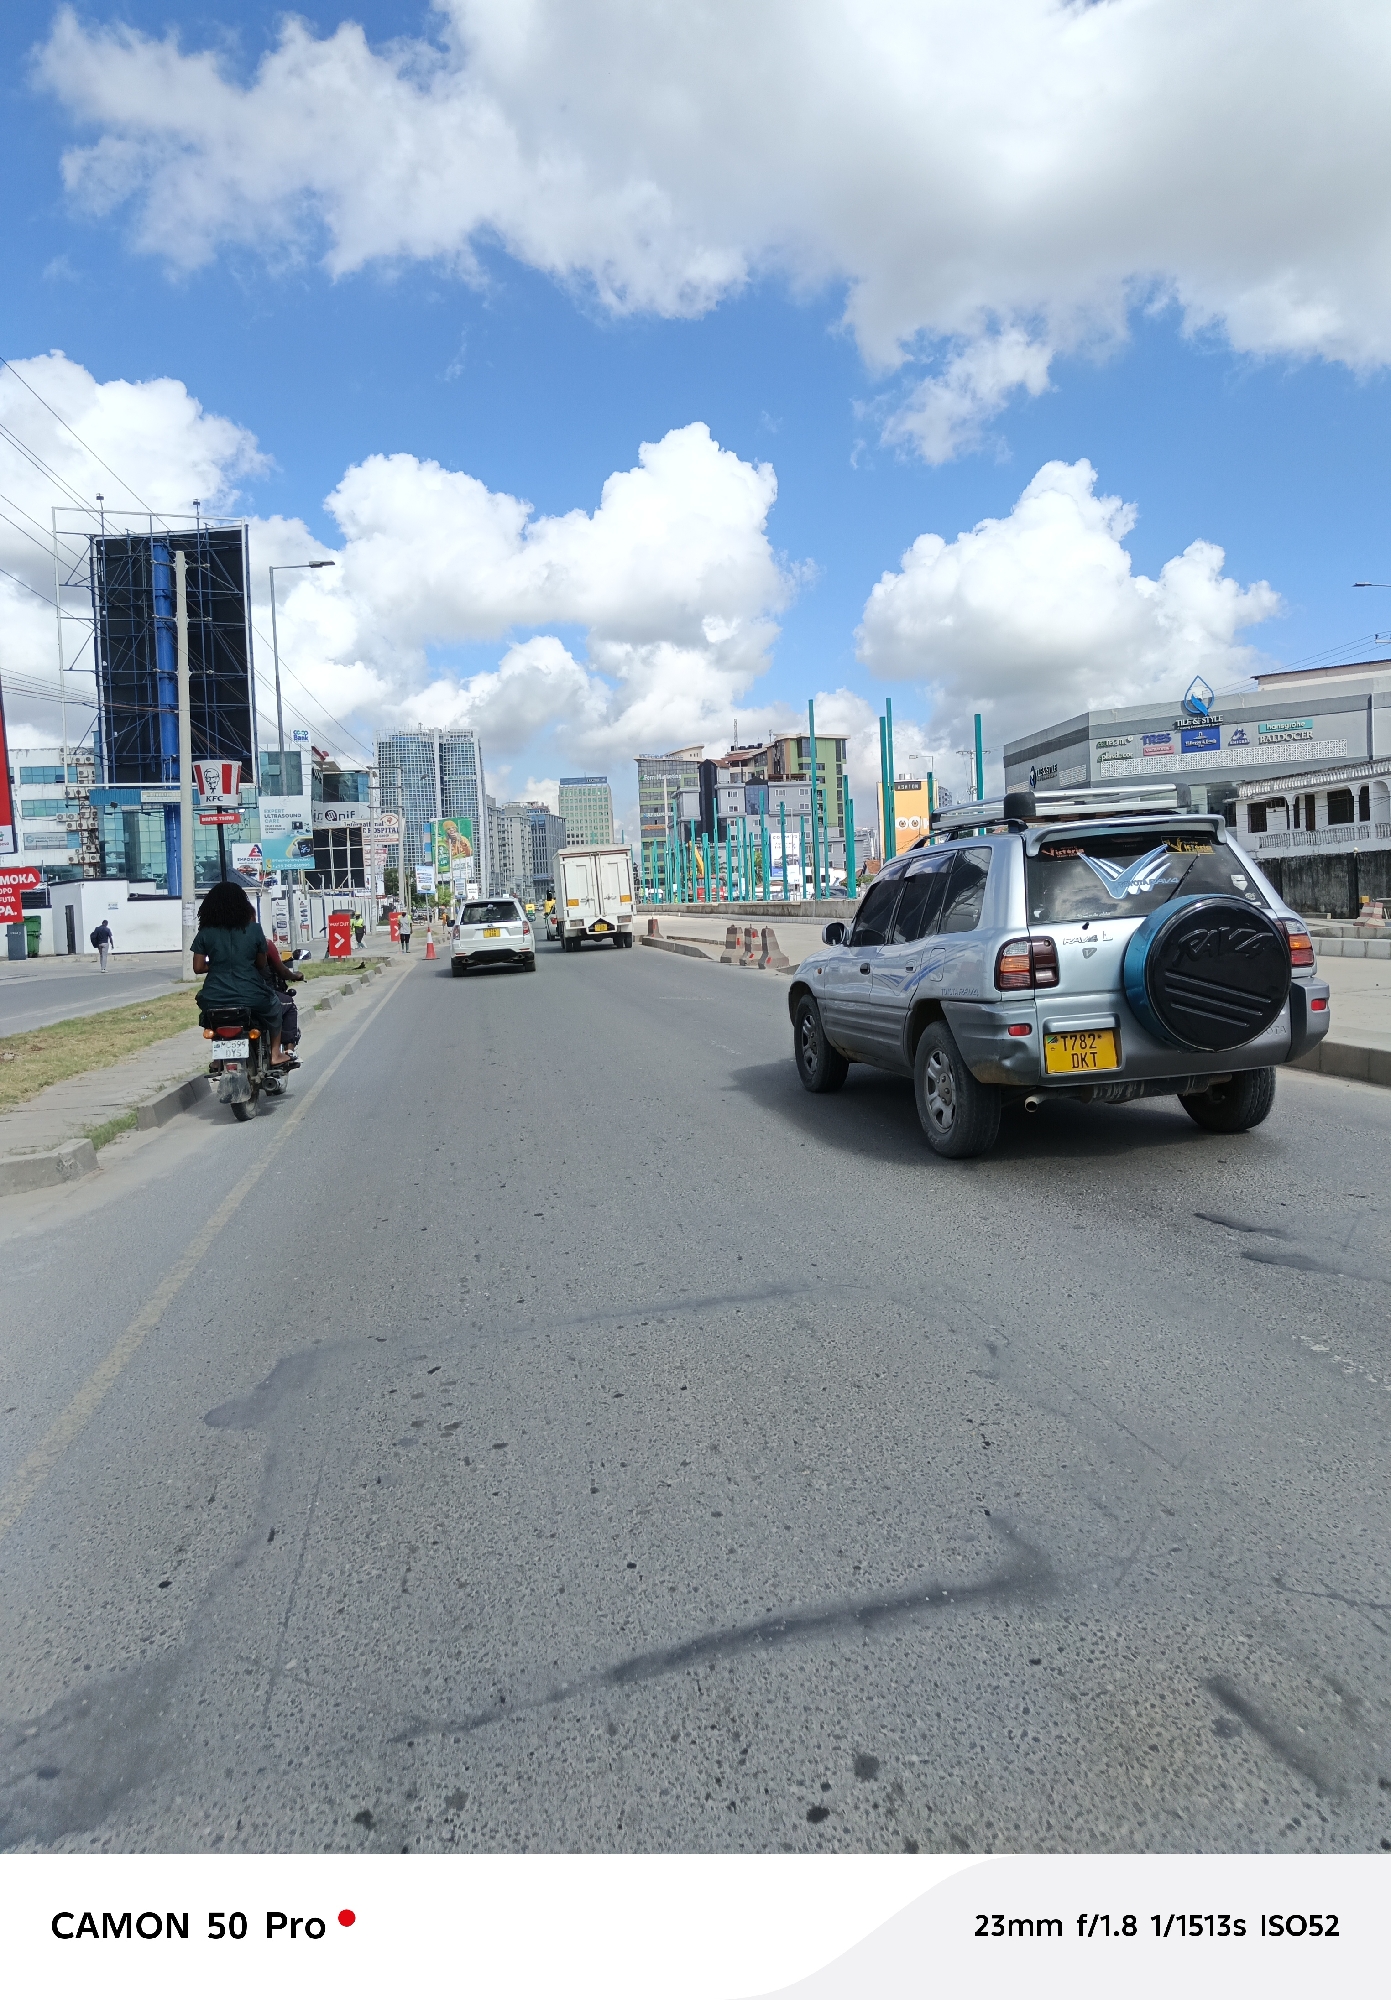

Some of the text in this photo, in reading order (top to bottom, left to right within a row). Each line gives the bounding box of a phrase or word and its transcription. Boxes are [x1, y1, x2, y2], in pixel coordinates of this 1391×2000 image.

[1177, 719, 1191, 727] TILE
[1202, 715, 1223, 723] STYLE
[1267, 722, 1306, 731] hansgrohe
[1143, 733, 1171, 745] TRES
[1259, 731, 1314, 744] BALDOCER
[1061, 1033, 1097, 1051] T782
[1071, 1051, 1098, 1069] DKT
